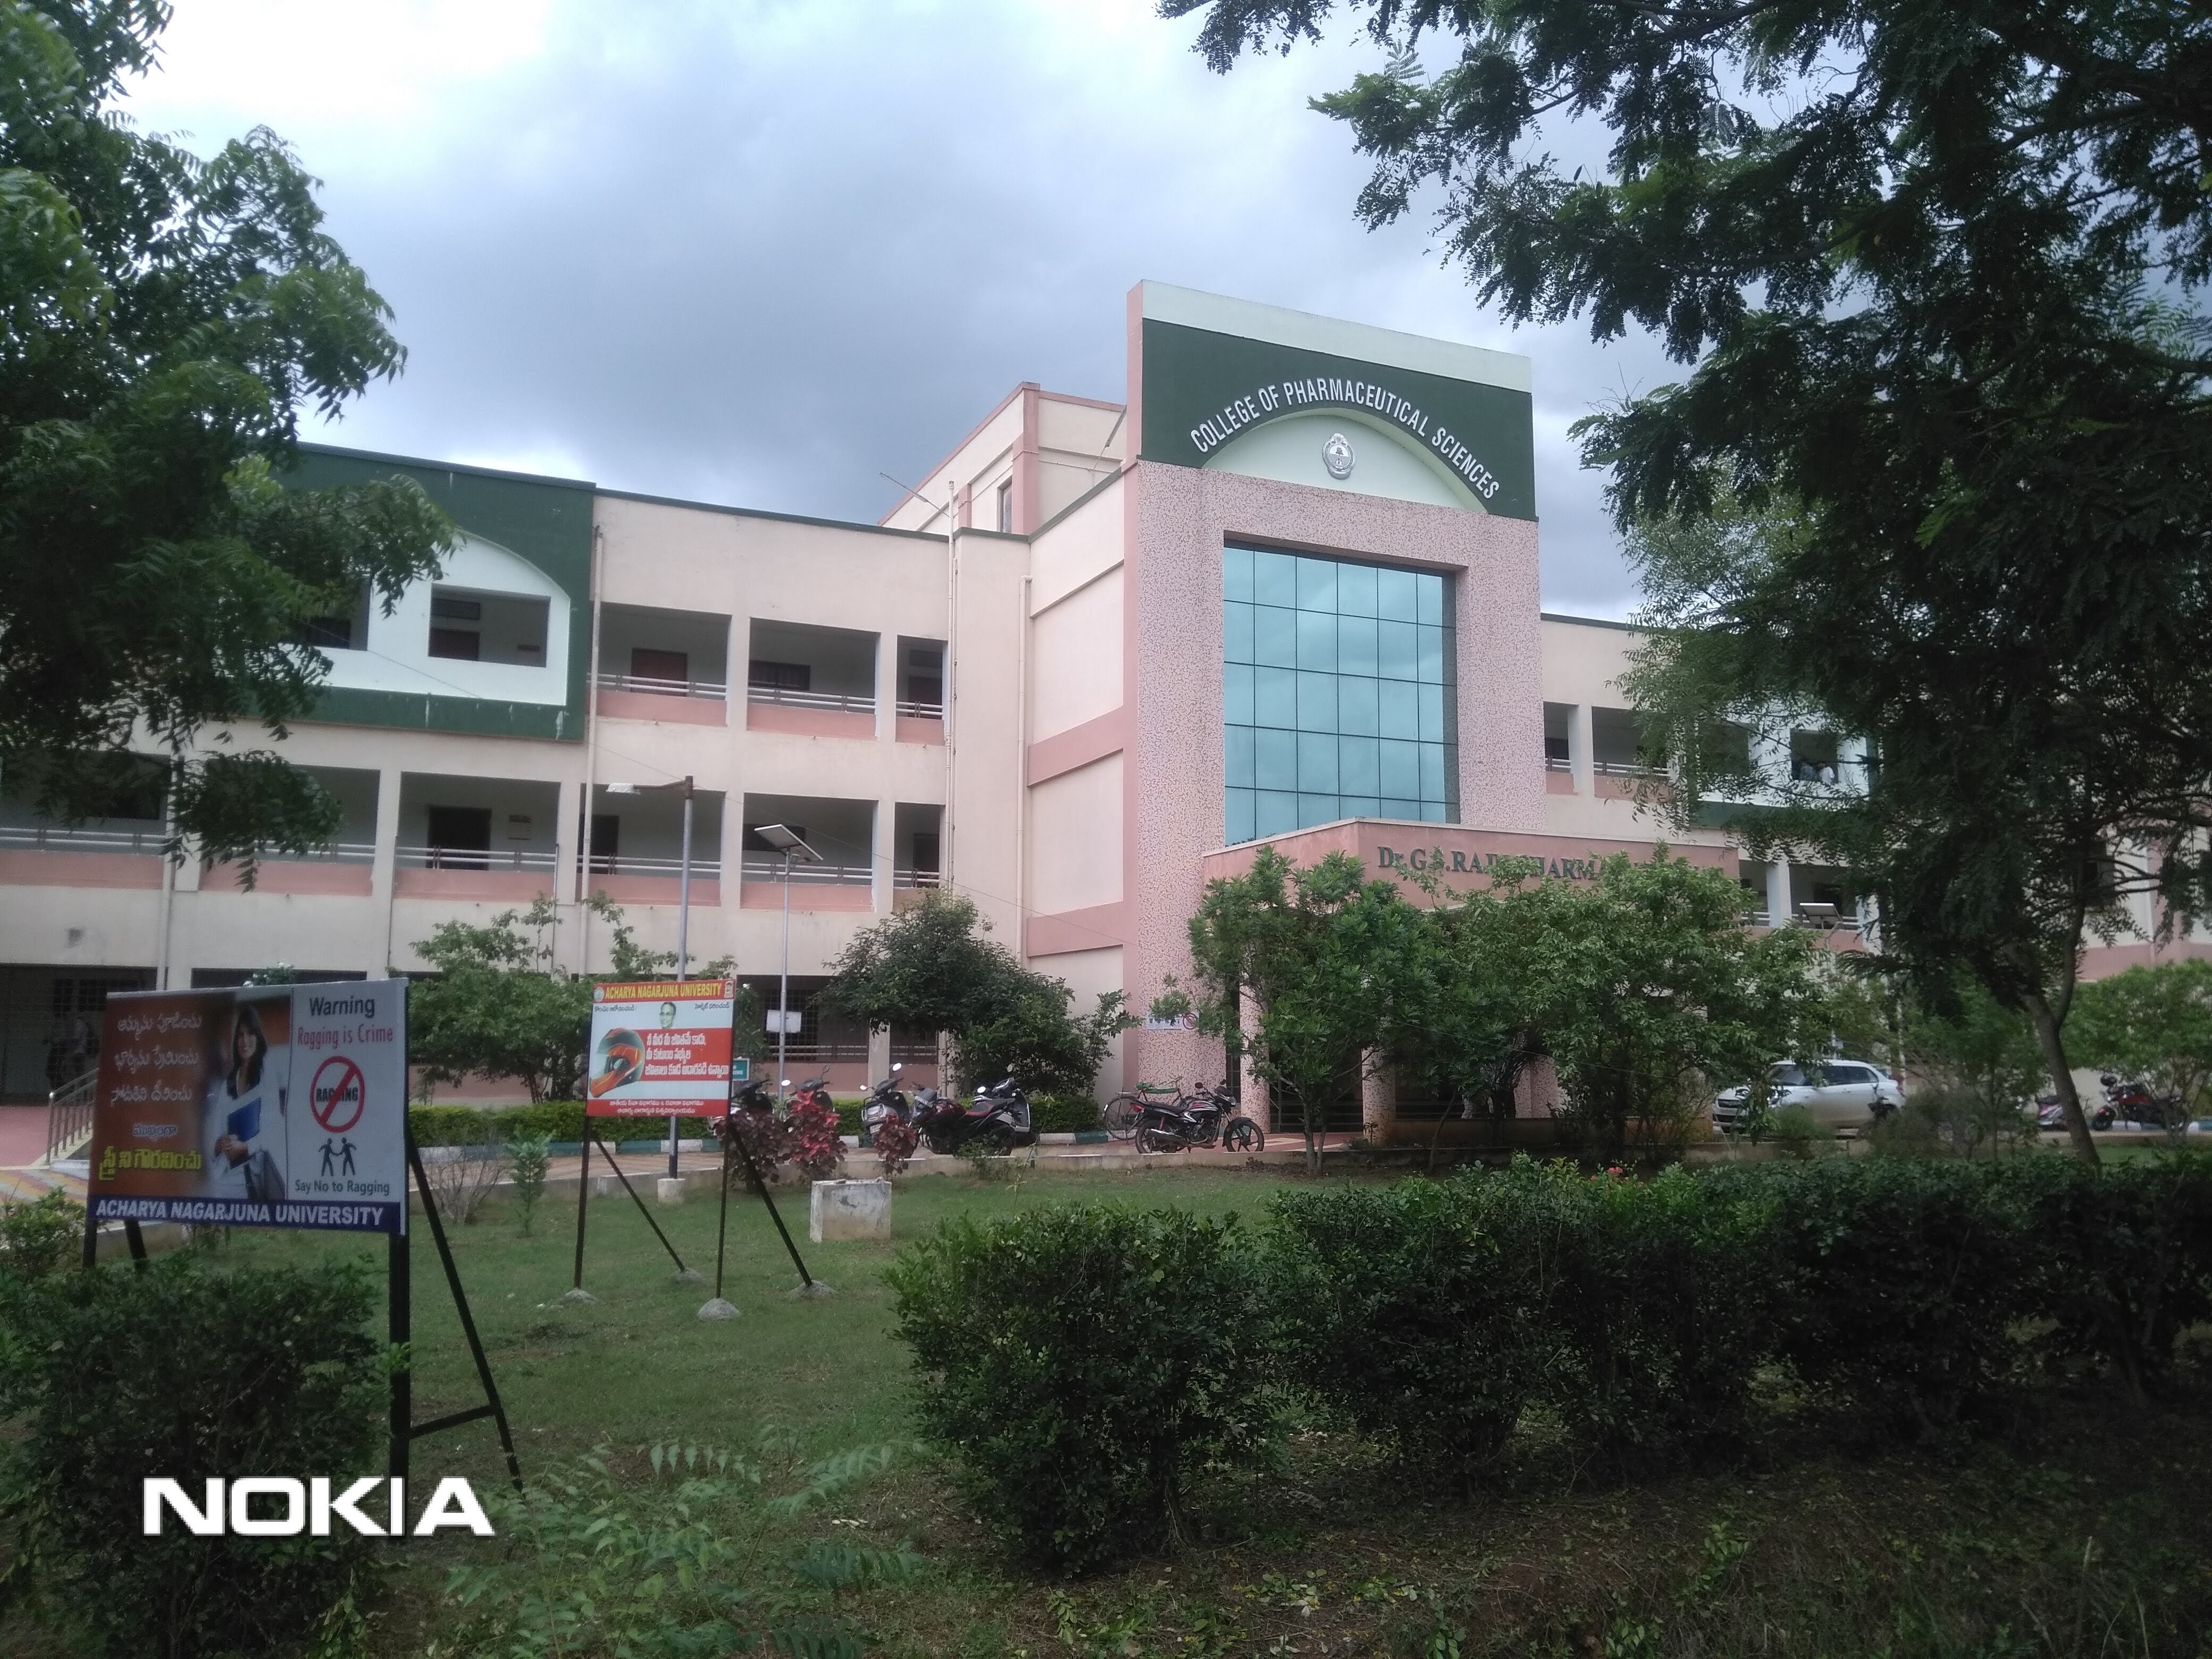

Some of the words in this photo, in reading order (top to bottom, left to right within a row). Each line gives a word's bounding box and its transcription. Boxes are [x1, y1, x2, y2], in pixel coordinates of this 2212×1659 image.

[1190, 395, 1260, 453] COLLEGE
[1258, 384, 1280, 413] OF
[1282, 377, 1429, 437] PHARMACEUTICAL
[1431, 426, 1499, 500] SCIENCES
[605, 986, 635, 999] ACHARYA
[638, 985, 678, 998] NAGARJUNA
[681, 983, 722, 996] UNIVERSITY
[309, 995, 375, 1018] Warning
[298, 1026, 339, 1050] Ragging
[343, 1025, 353, 1043] is
[358, 1023, 393, 1043] Crime
[316, 1087, 358, 1102] RAGING
[295, 1180, 311, 1194] Say
[314, 1180, 329, 1192] No
[332, 1181, 344, 1192] to
[347, 1180, 390, 1196] Ragging
[96, 1199, 167, 1218] ACHARYA
[171, 1201, 270, 1222] NAGARJUNA
[275, 1205, 384, 1226] UNIVERSITY
